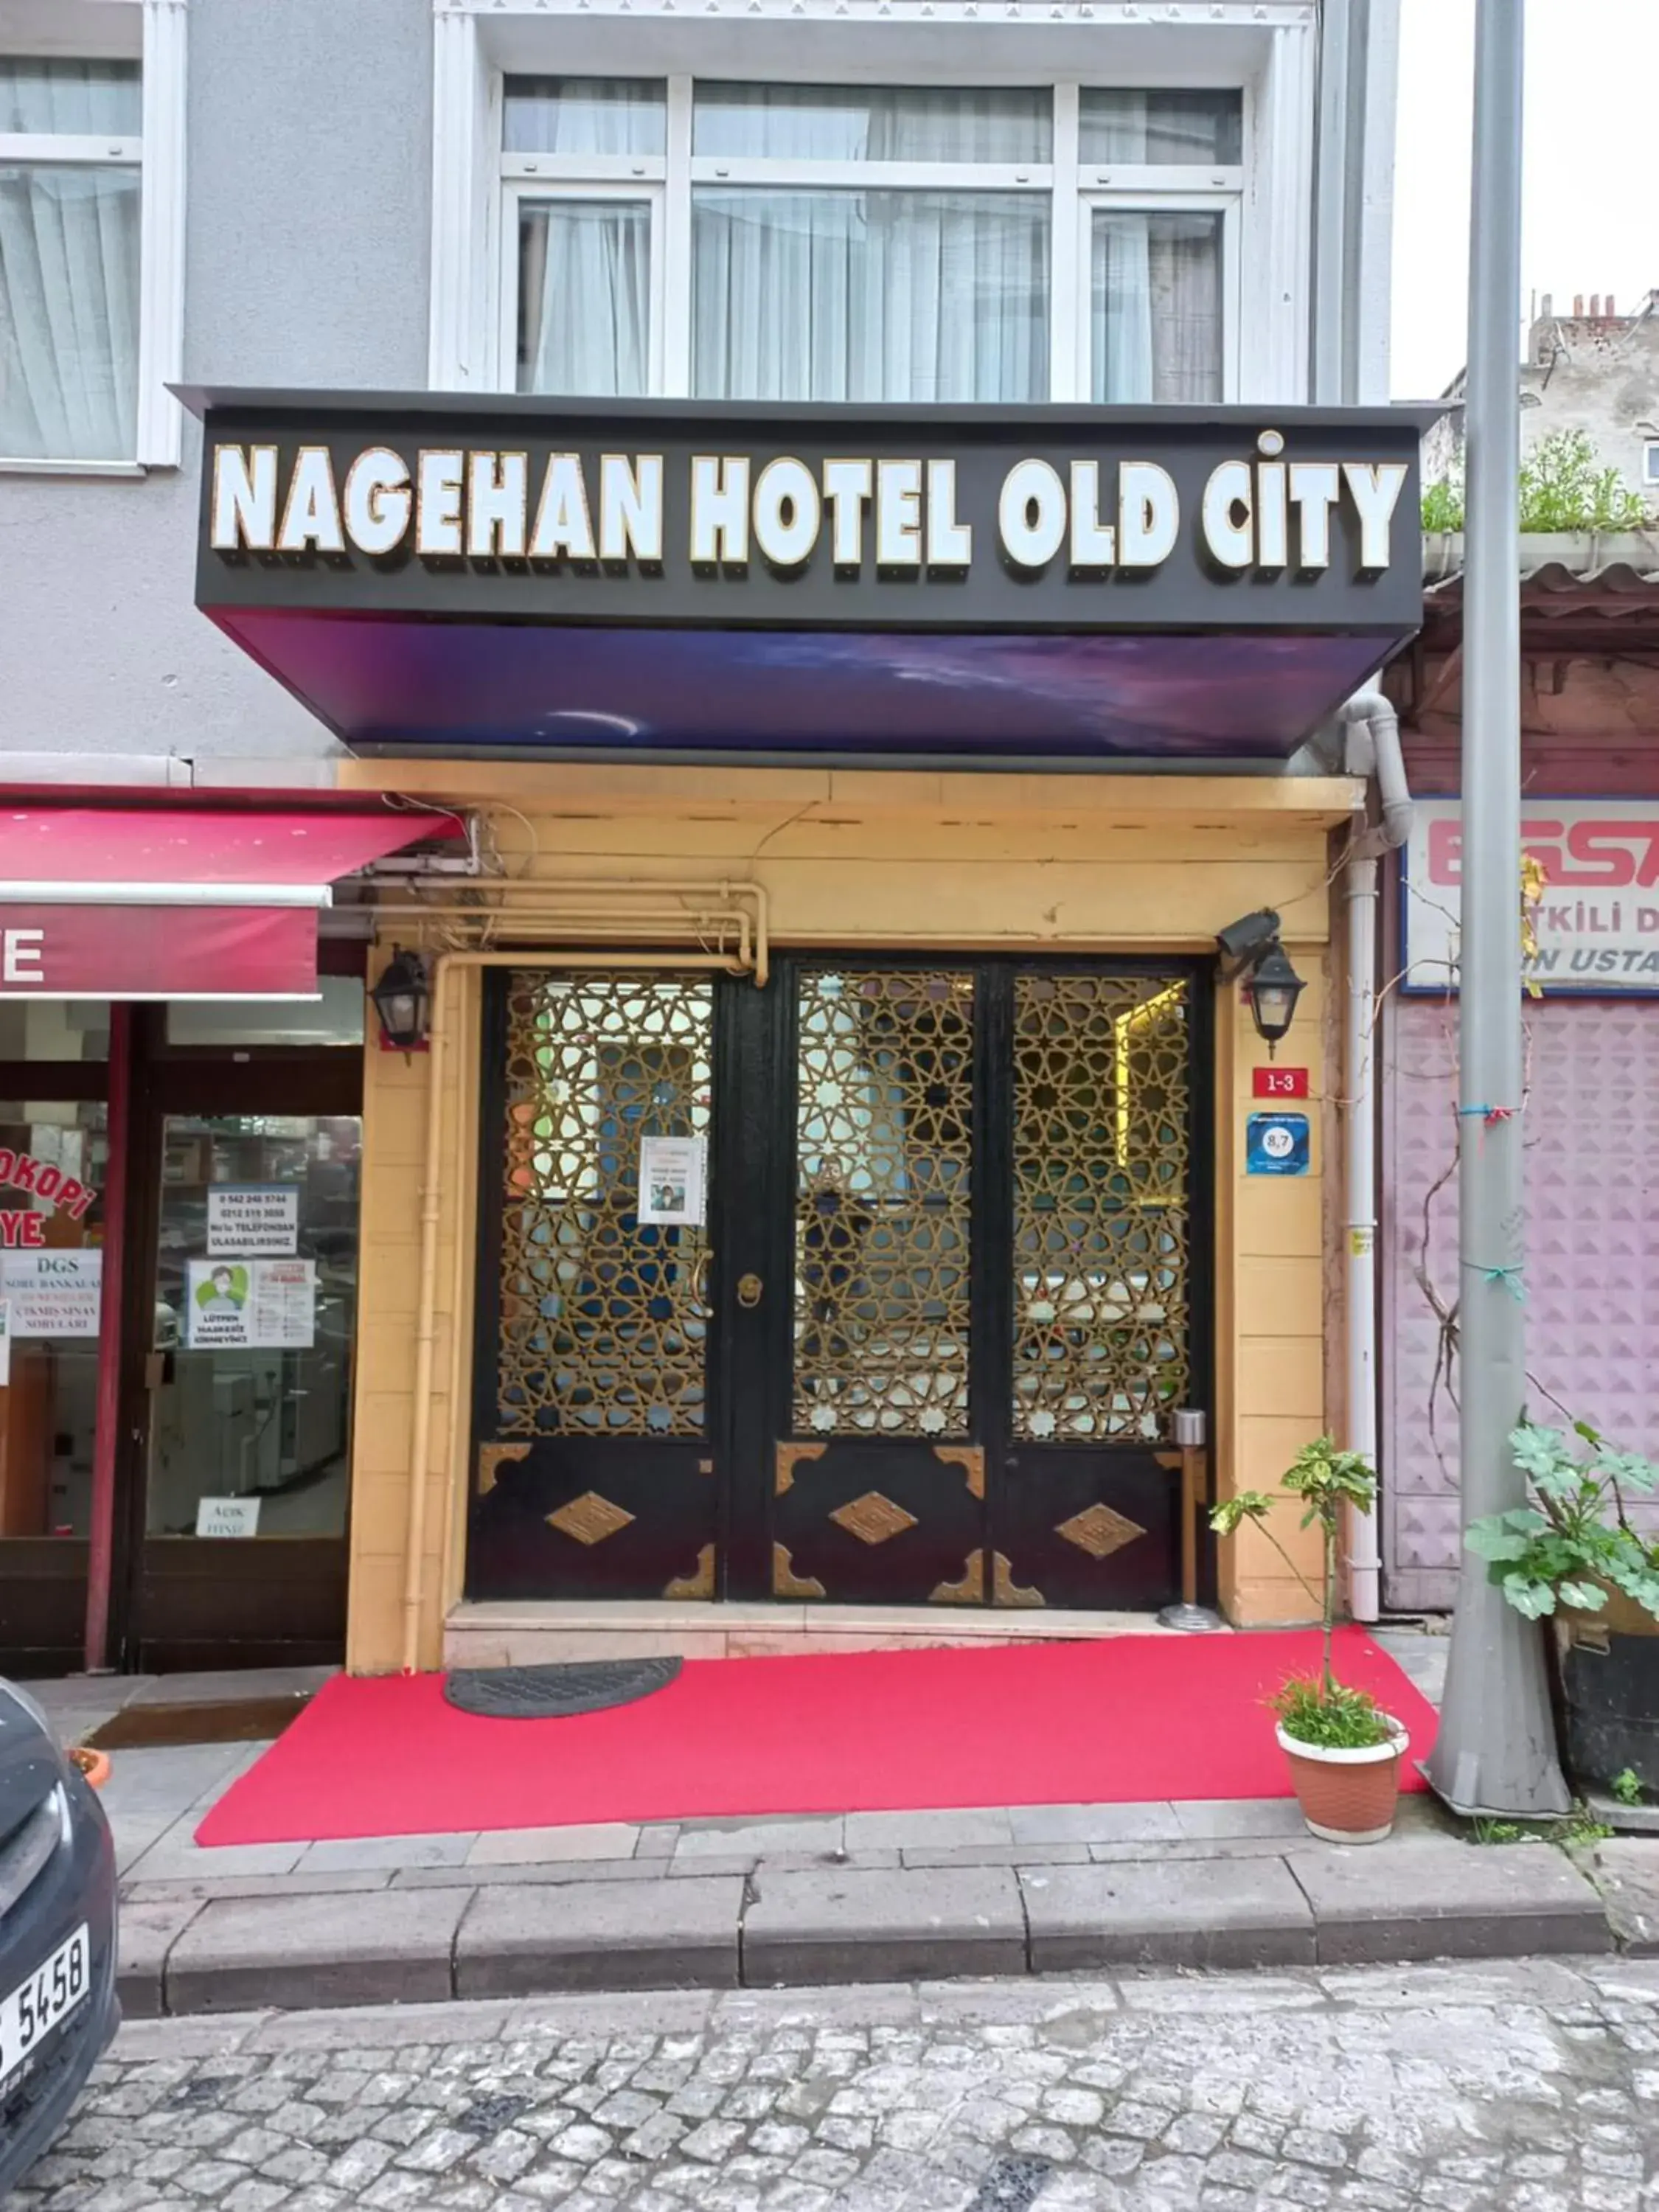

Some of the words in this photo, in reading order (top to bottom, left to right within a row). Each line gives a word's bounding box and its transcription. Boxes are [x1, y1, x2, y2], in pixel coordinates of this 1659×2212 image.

[210, 445, 664, 561] NAGEHAN
[690, 455, 972, 566] HOTEL
[998, 458, 1180, 567] OLD
[1522, 901, 1621, 933] TKİLİ
[0, 929, 44, 981] E
[1267, 1074, 1295, 1091] 1-3
[37, 1257, 80, 1273] DGS
[18, 1938, 83, 2048] 5458
